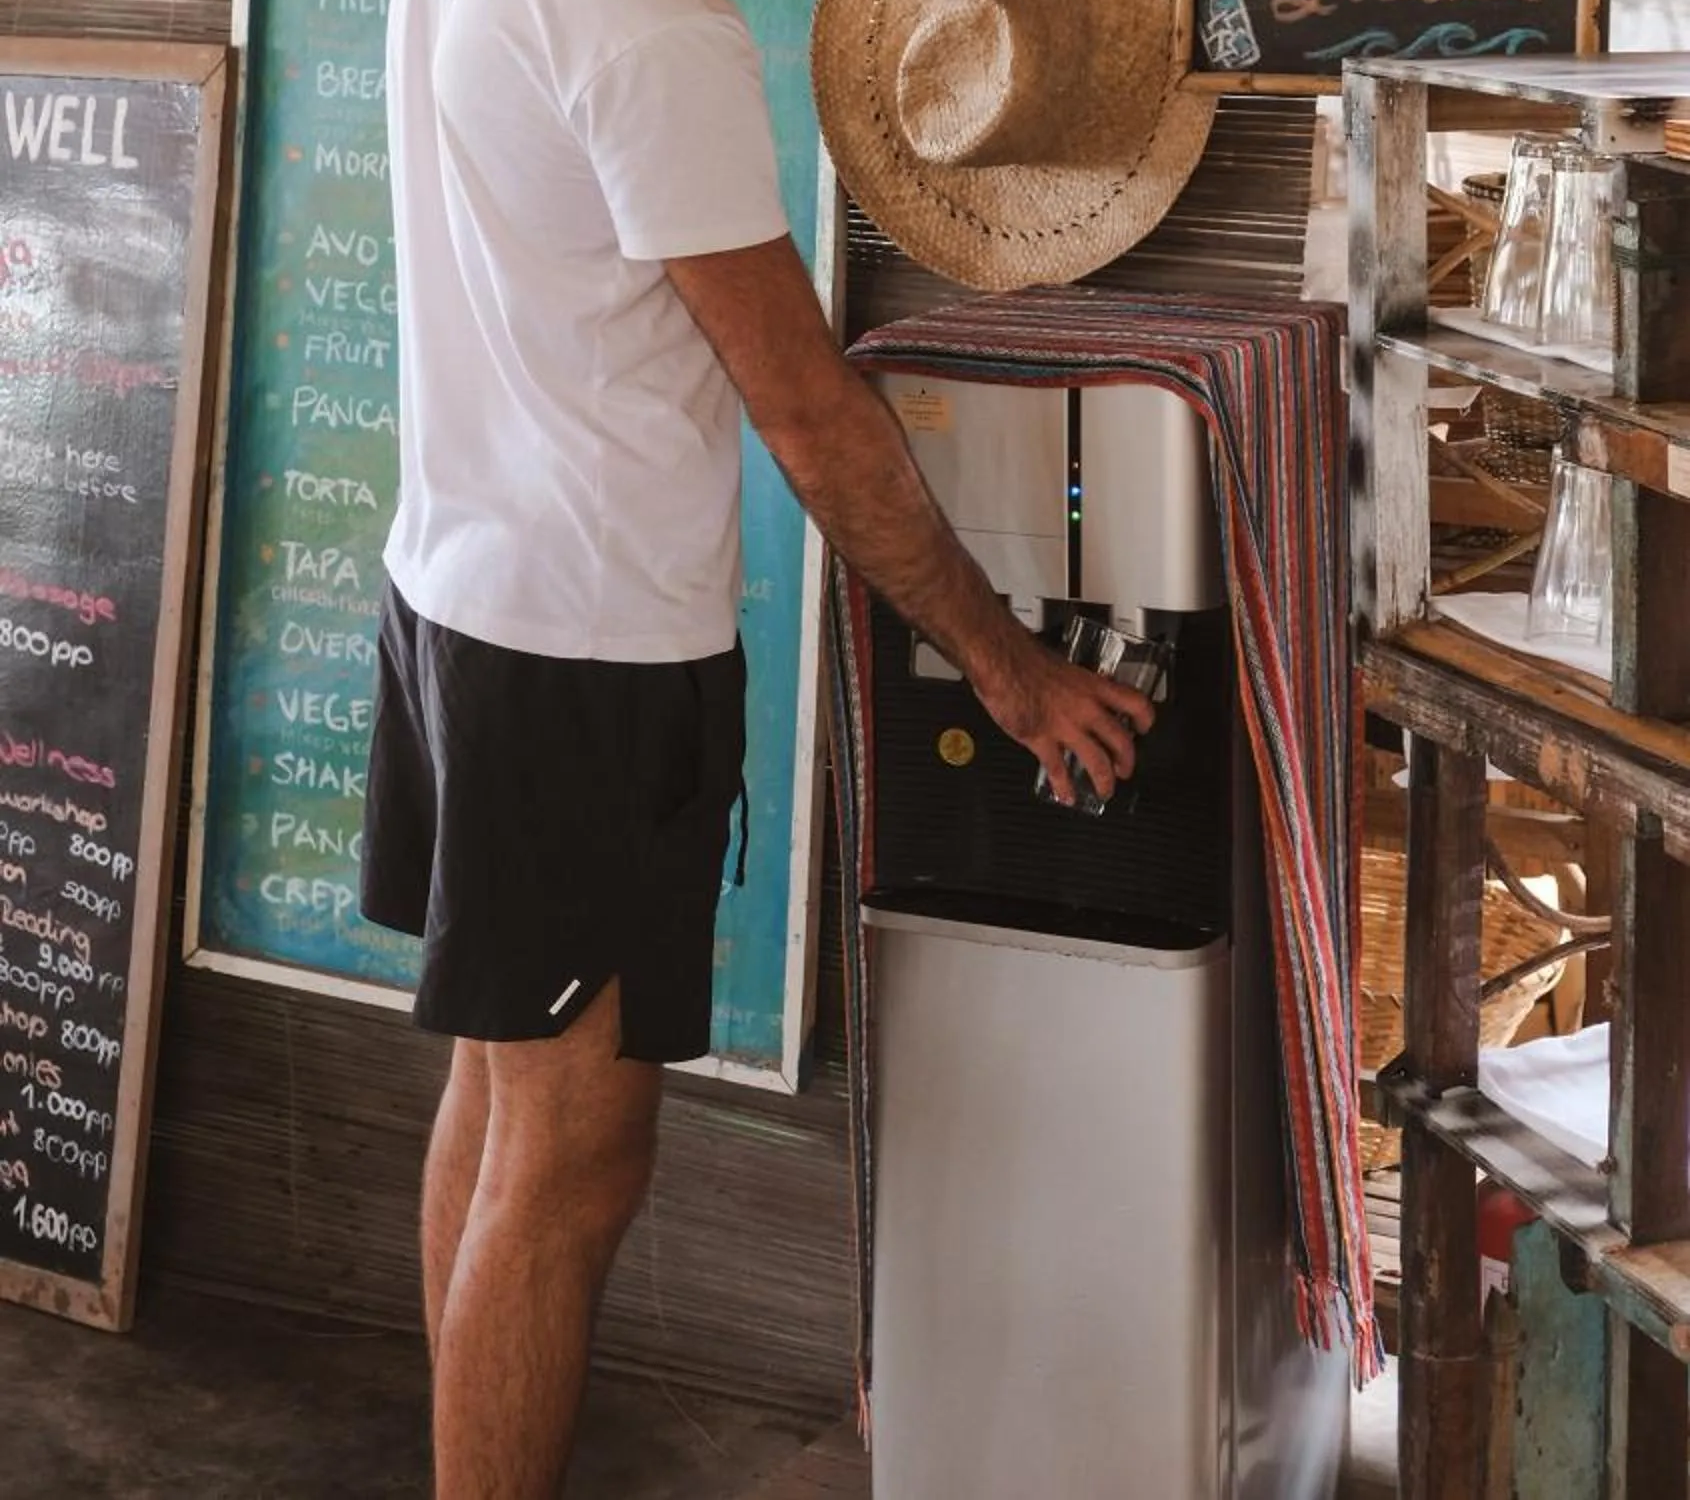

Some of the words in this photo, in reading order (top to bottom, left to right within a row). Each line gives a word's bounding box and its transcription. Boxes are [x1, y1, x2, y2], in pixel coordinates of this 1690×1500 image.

[5, 90, 139, 169] WELL
[304, 331, 392, 370] FRUIT
[64, 442, 124, 473] here
[63, 470, 138, 503] before
[283, 468, 378, 511] TORTA
[279, 540, 361, 591] TAPA
[68, 832, 134, 884] 800pp
[61, 1018, 121, 1069] 800pp
[33, 1127, 108, 1182] 800pp
